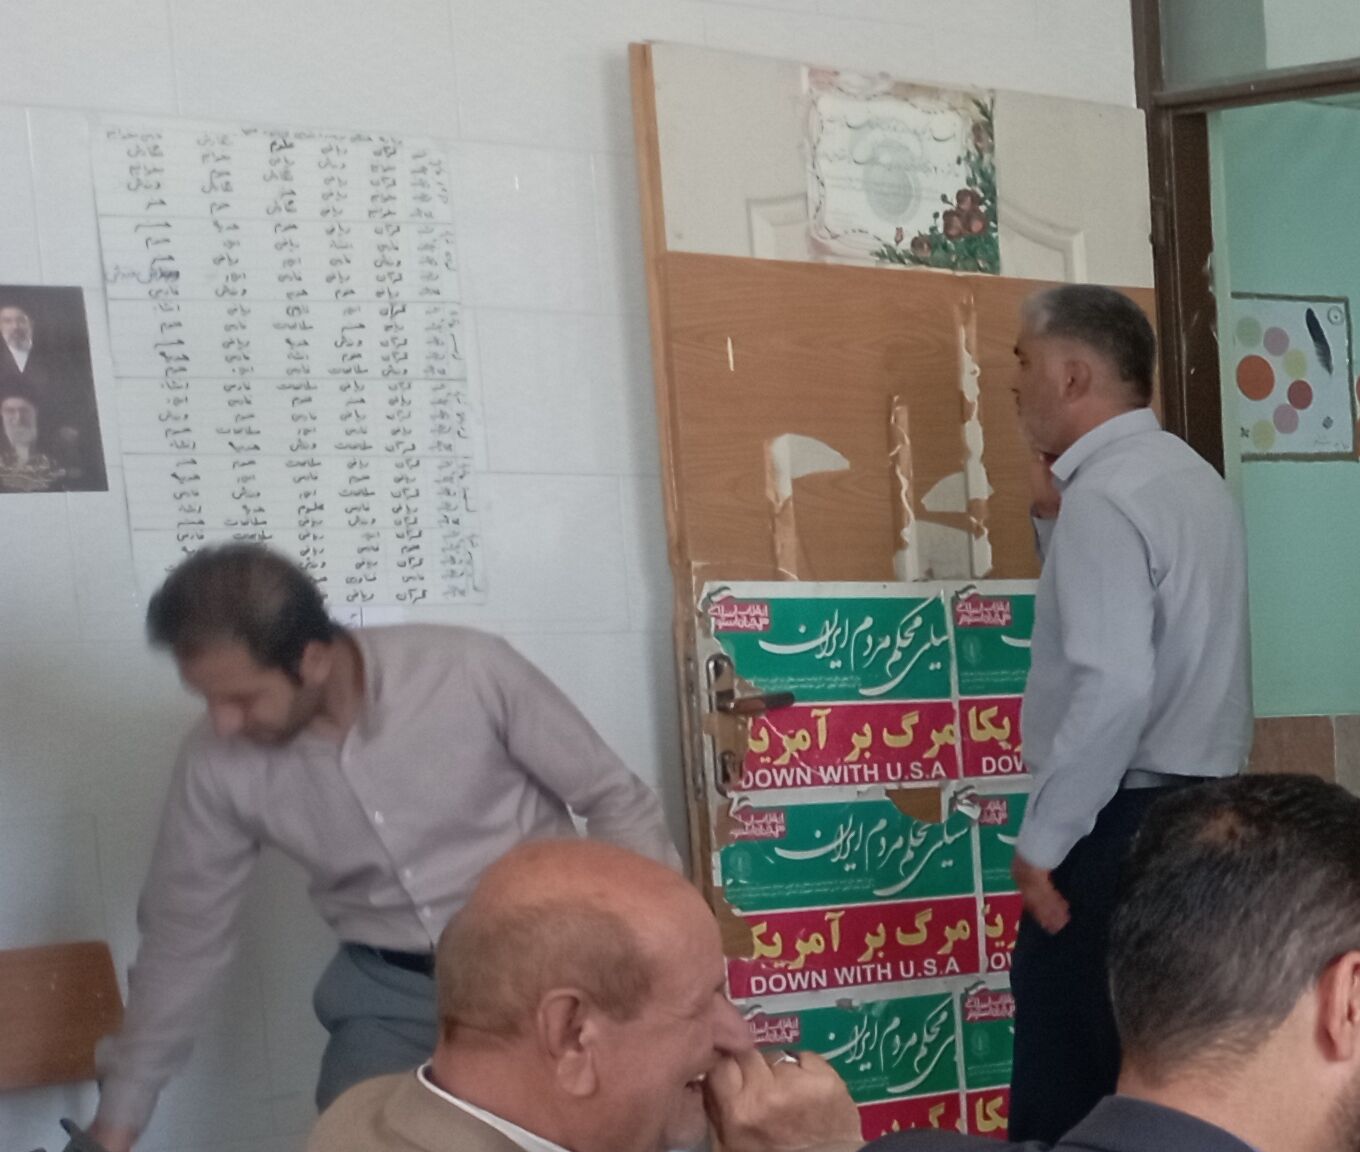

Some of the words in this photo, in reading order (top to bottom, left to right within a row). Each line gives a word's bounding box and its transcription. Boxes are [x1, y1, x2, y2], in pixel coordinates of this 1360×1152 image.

[845, 722, 872, 763] بر
[818, 763, 879, 784] WITH
[886, 761, 946, 781] U.S.A
[751, 909, 845, 970] آمریک
[857, 922, 886, 963] بر
[895, 907, 971, 955] مرگ
[751, 969, 827, 994] DOWN
[833, 962, 892, 984] WITH
[899, 956, 960, 978] U.S.A
